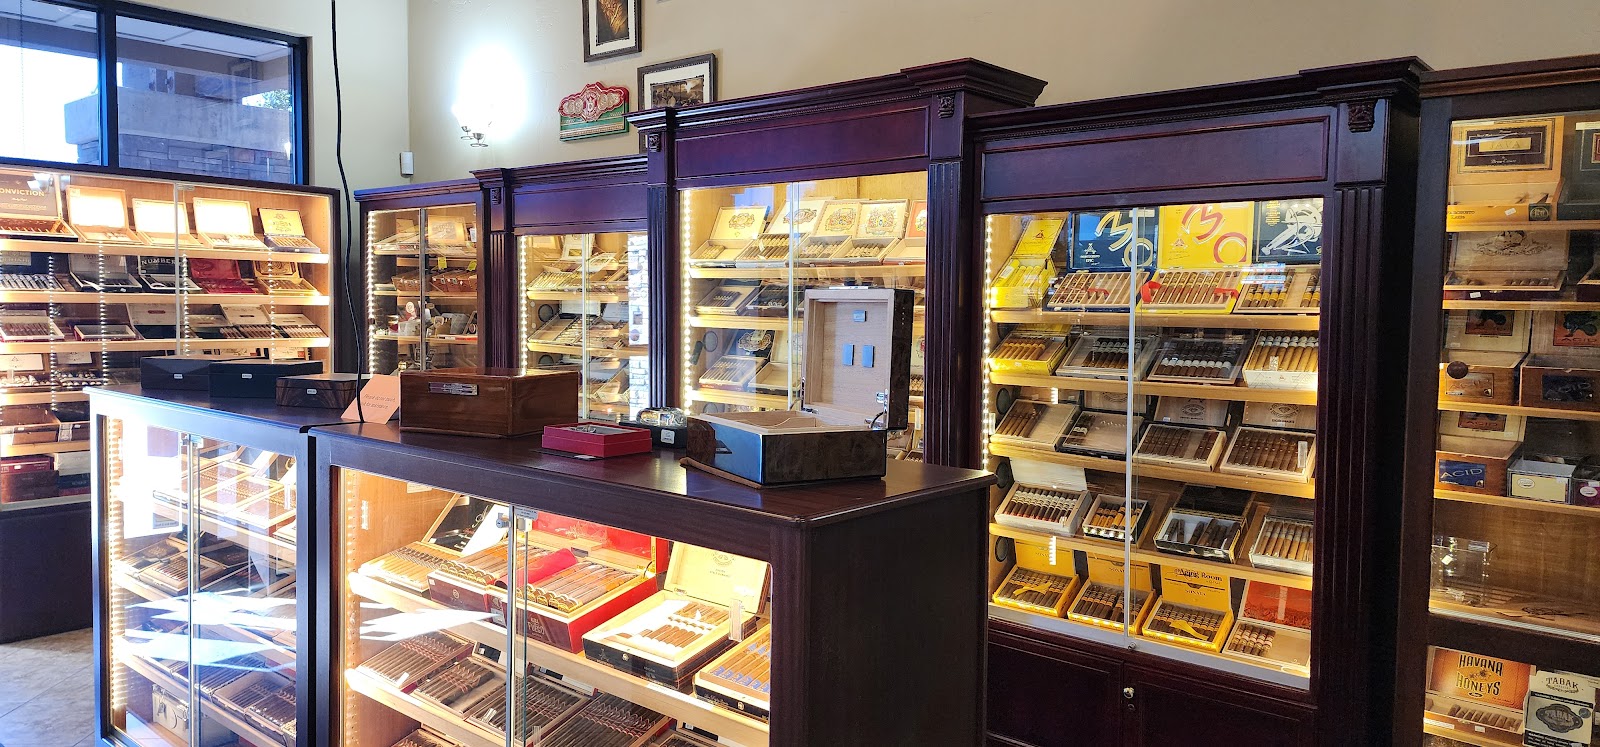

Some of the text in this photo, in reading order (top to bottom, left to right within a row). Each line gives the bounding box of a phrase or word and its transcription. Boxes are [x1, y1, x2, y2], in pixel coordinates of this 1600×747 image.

[1489, 140, 1521, 150] JAVA
[1440, 468, 1483, 479] ACID
[1201, 572, 1223, 581] Room
[1459, 653, 1504, 677] HAVANA
[1456, 671, 1501, 696] HONEYS
[1546, 677, 1579, 689] TABAK
